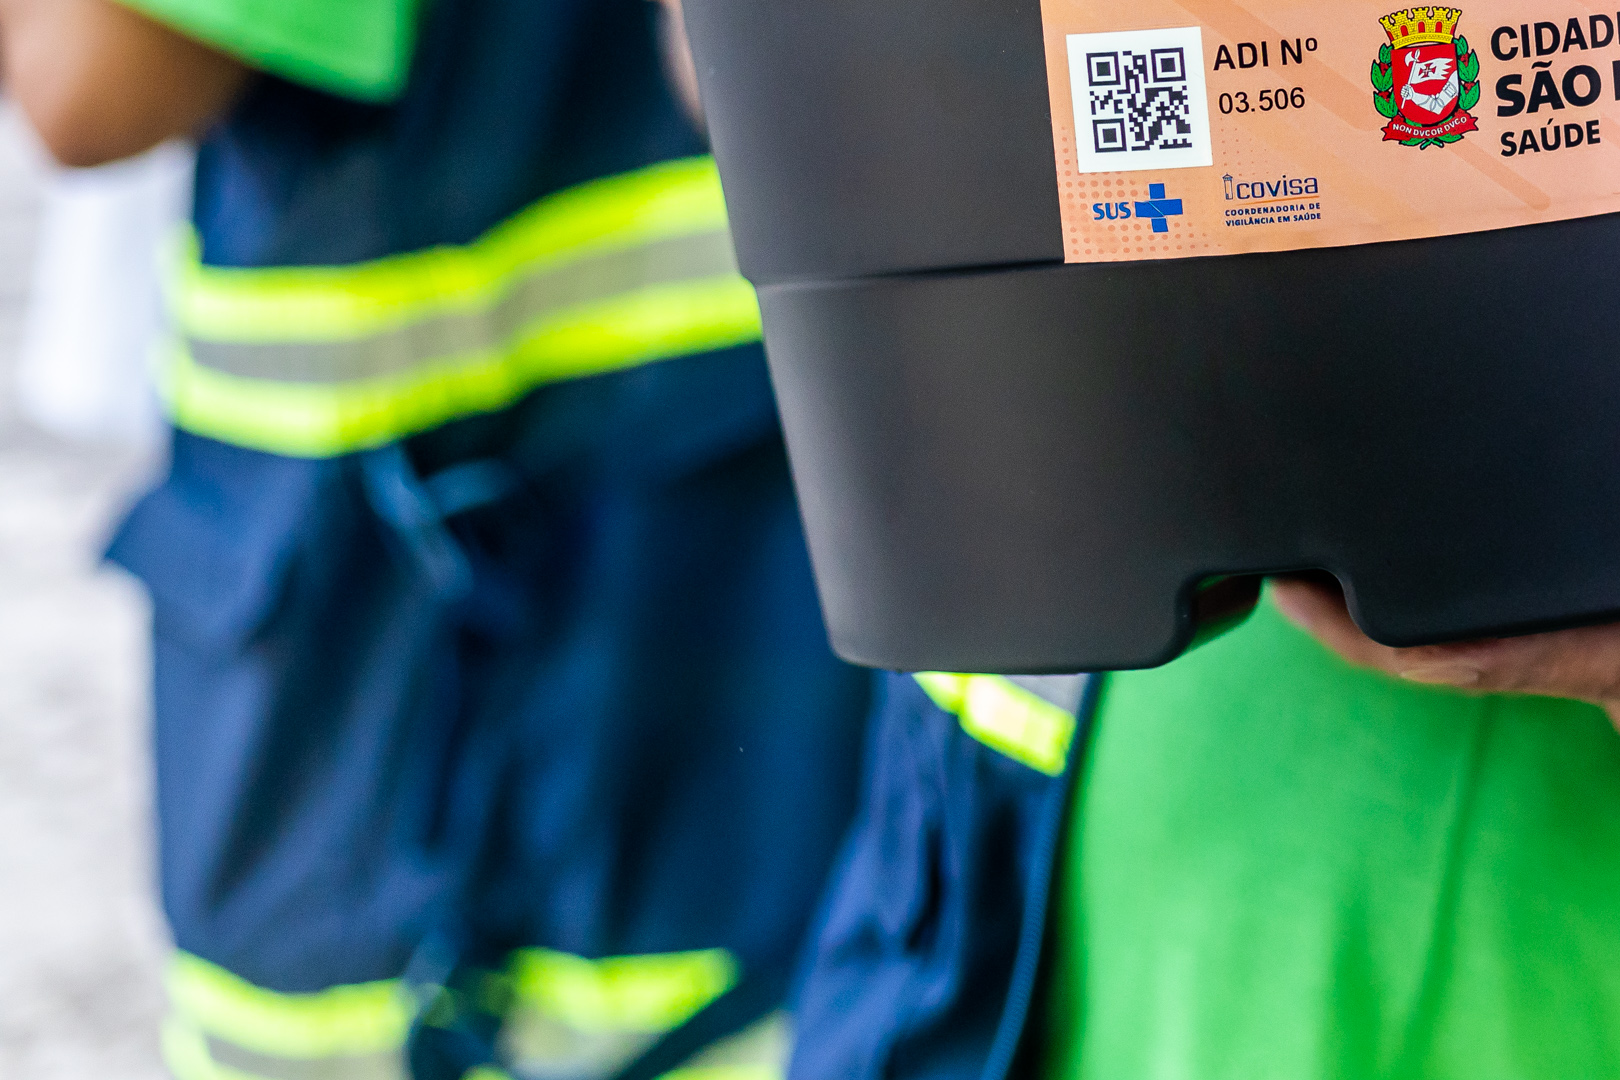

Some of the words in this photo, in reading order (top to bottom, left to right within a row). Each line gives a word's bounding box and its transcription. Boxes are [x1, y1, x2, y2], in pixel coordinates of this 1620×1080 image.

[1213, 40, 1269, 71] ADI
[1218, 86, 1306, 115] 03.506
[1495, 60, 1602, 117] SÃO
[1392, 123, 1412, 135] NON
[1500, 118, 1601, 157] SAÚDE
[1236, 174, 1319, 200] covisa
[1092, 201, 1132, 220] SUS
[1225, 203, 1305, 217] COORDENADORIA
[1309, 202, 1321, 210] DE
[1225, 216, 1275, 227] VIGILÂNCIA
[1277, 215, 1290, 223] EM
[1293, 212, 1321, 222] SAÚDE
